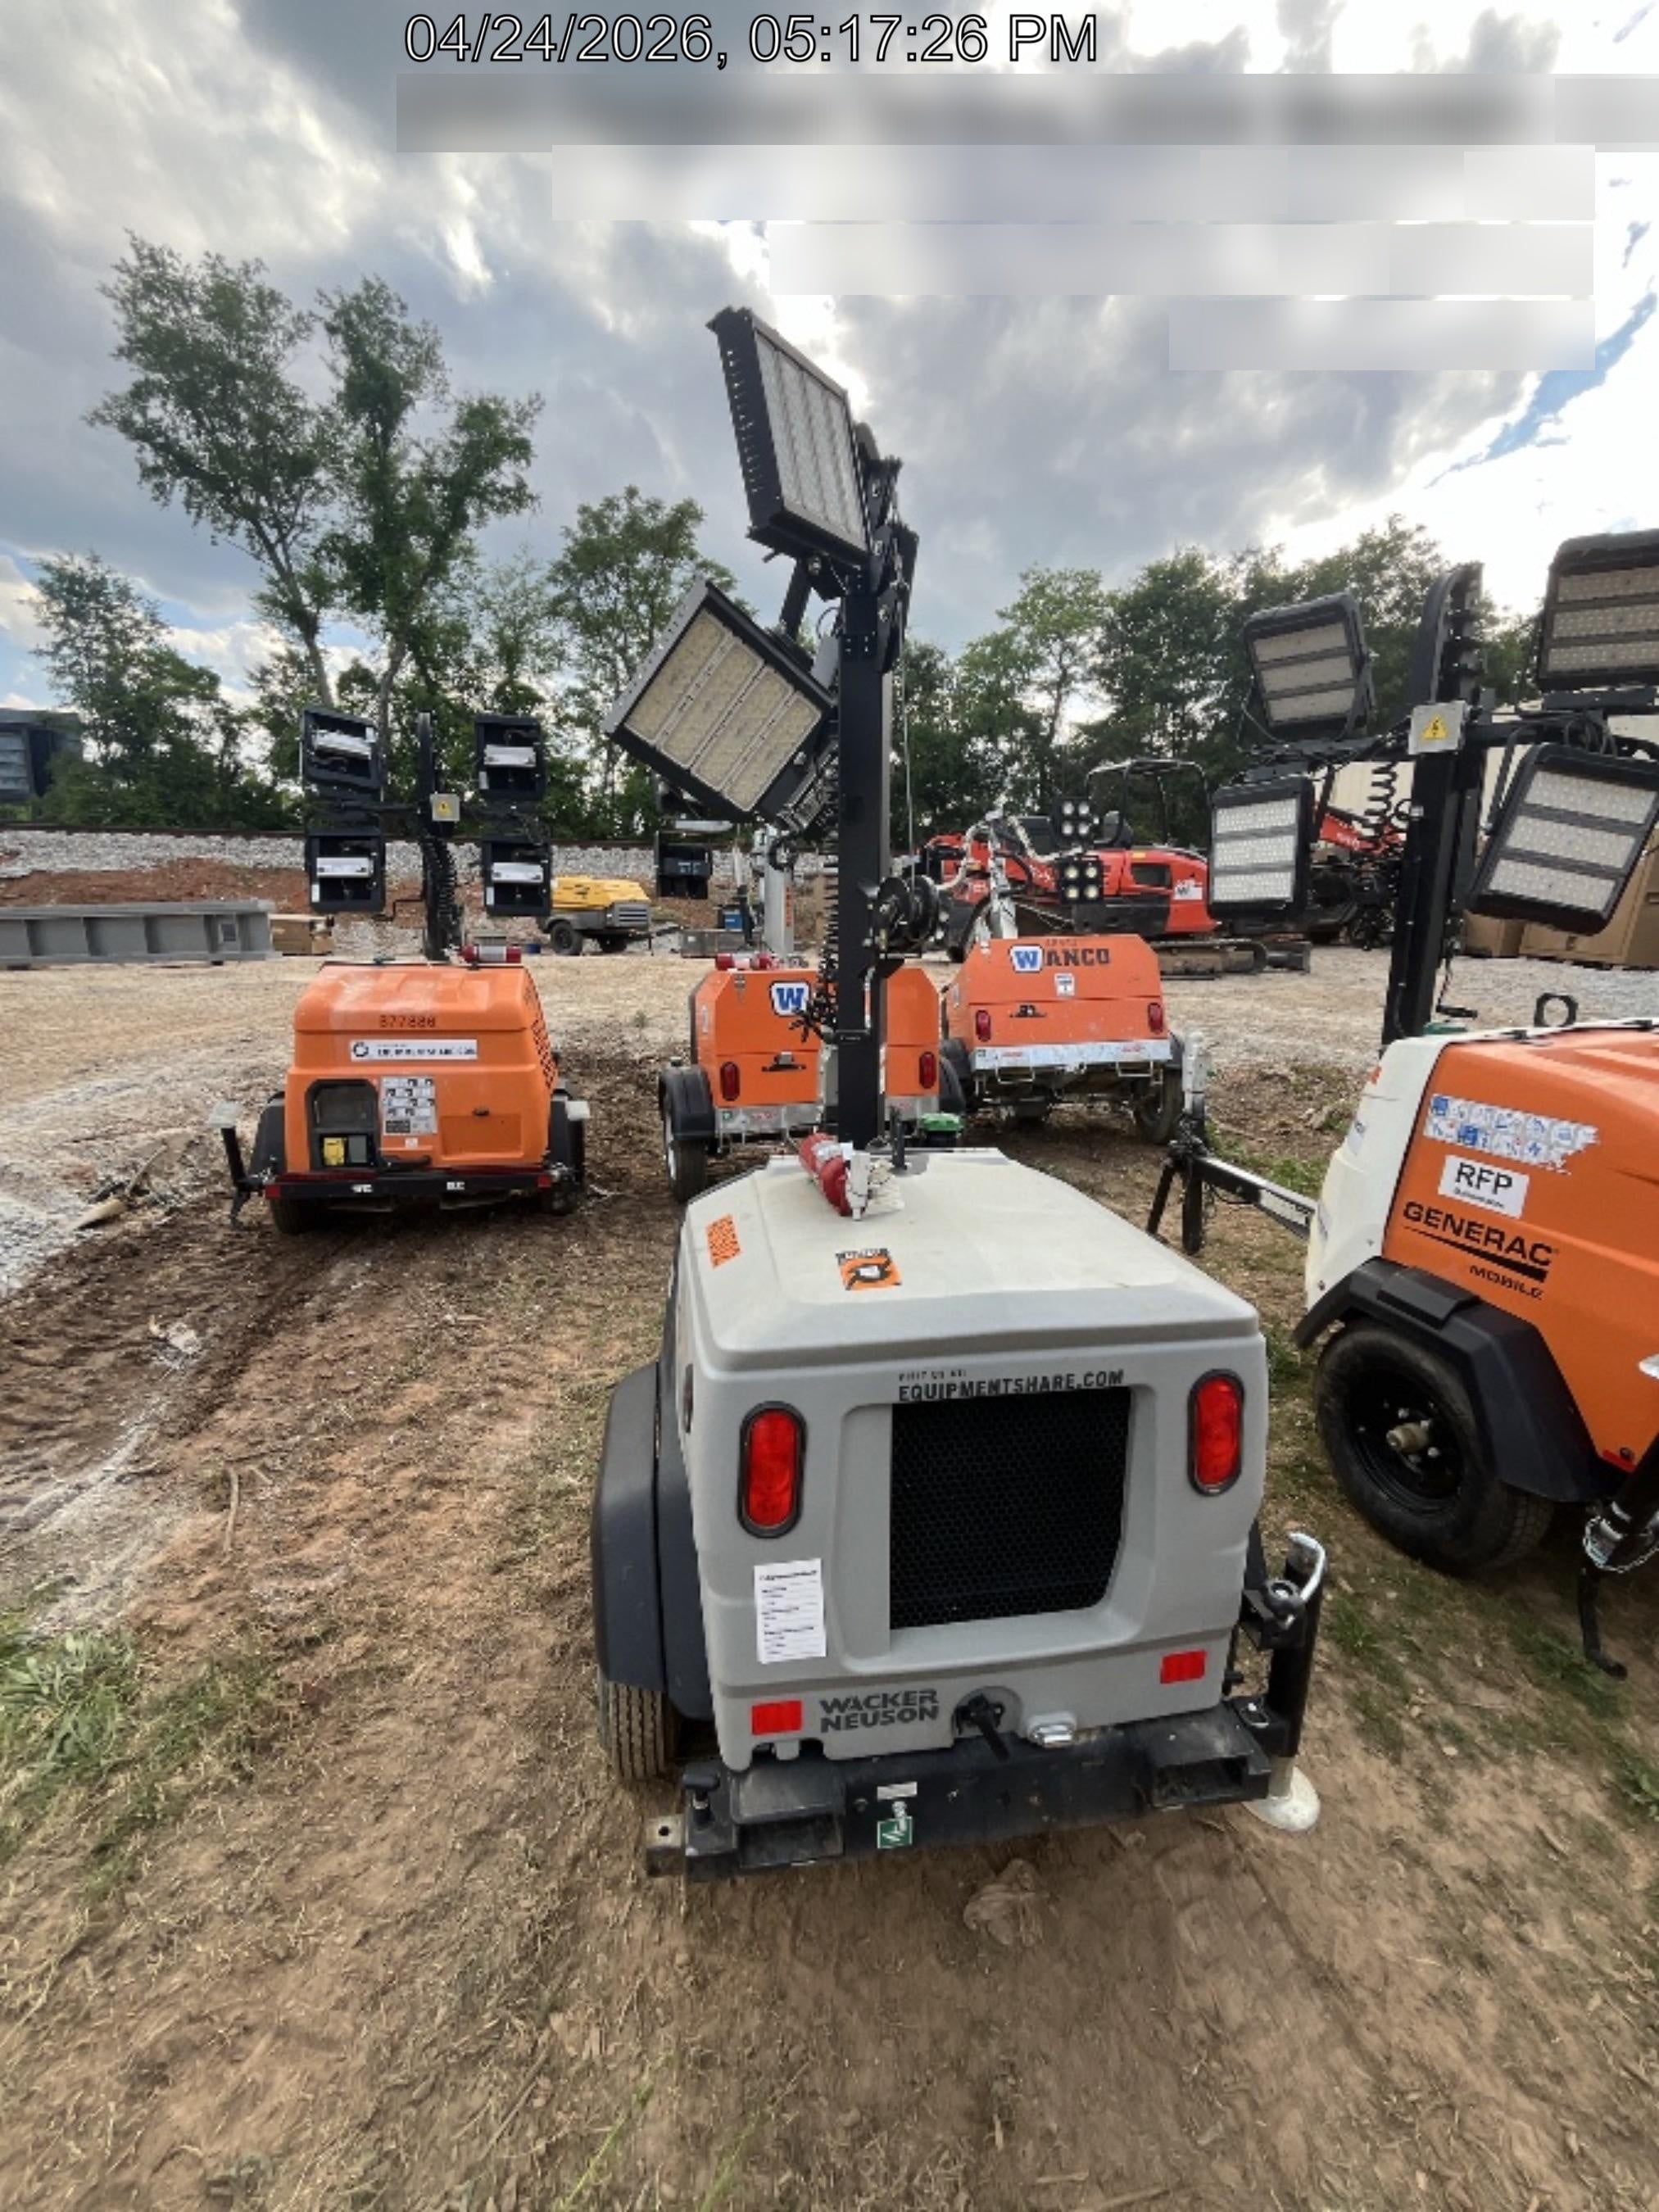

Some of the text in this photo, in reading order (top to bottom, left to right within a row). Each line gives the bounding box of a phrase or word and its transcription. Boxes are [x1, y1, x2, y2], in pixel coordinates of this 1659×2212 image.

[1011, 947, 1110, 969] WANCO
[1455, 1161, 1513, 1195] RFP
[1403, 1201, 1553, 1267] GENERAC
[1470, 1265, 1544, 1301] MOBILE
[899, 1367, 1125, 1402] EQUIPMENTSHARE.COM
[819, 1688, 939, 1715] WACKER
[820, 1704, 939, 1734] NEUSON
